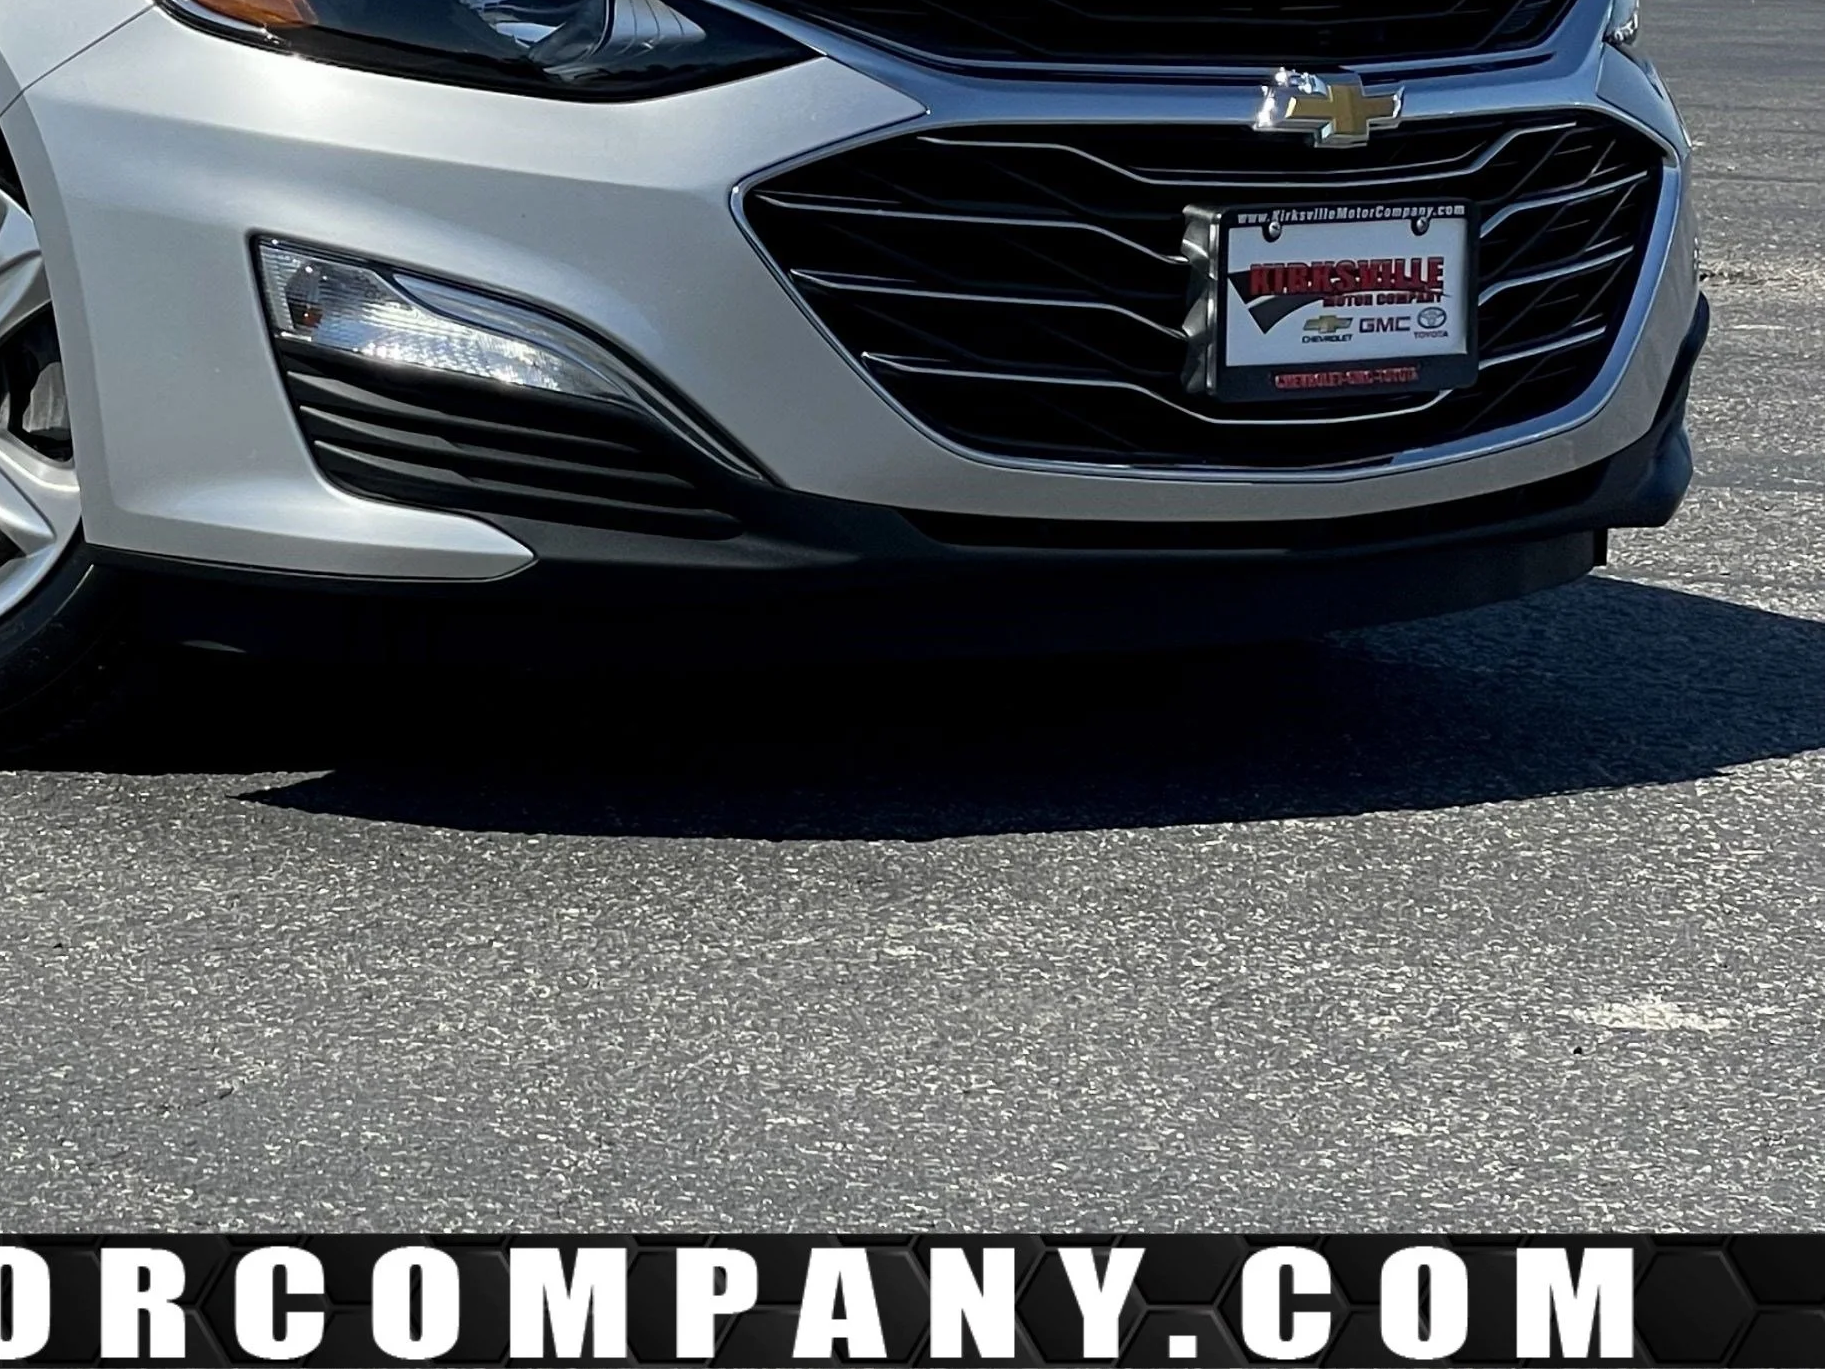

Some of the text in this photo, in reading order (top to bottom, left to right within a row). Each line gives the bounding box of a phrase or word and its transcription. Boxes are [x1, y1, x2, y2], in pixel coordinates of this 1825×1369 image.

[1237, 204, 1466, 224] www.KirksvilleMotorCompany.com
[1249, 257, 1444, 295] KIRKSVILLE
[1323, 291, 1442, 308] MOTOR COMPANY
[1359, 316, 1411, 333] GMC
[1301, 334, 1353, 344] CHEVROLET
[1414, 331, 1449, 339] TOYOTA
